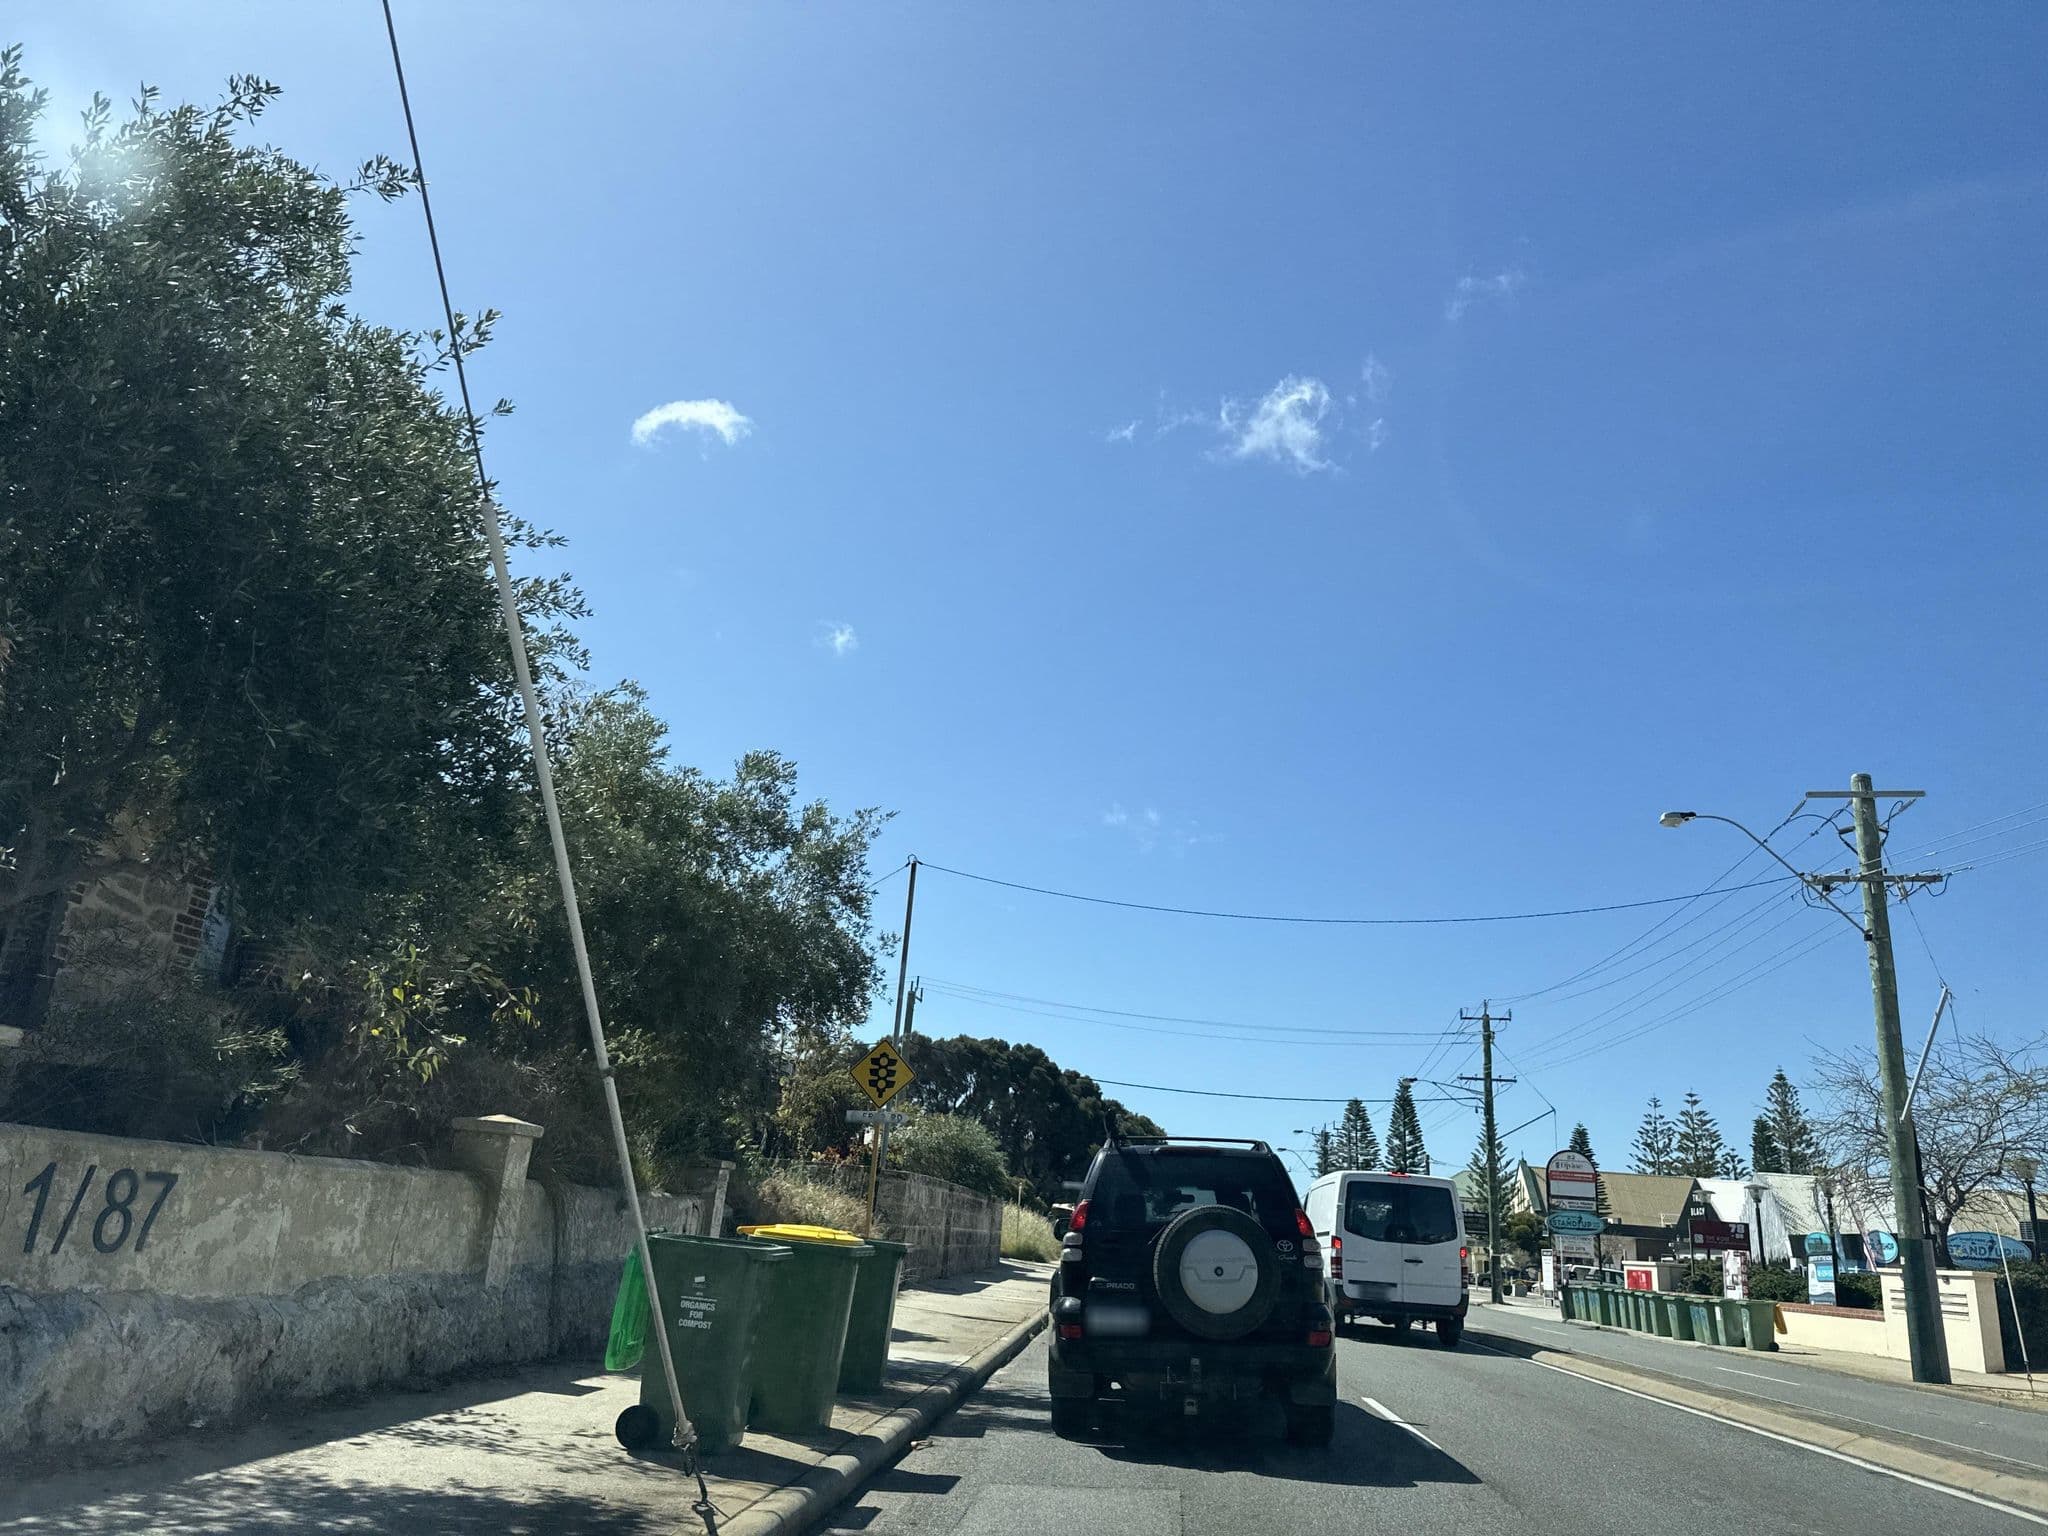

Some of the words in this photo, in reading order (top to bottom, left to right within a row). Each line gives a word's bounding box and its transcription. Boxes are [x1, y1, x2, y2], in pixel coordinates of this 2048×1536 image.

[23, 1161, 179, 1254] 1/87
[1729, 1223, 1745, 1233] 78
[1106, 1282, 1135, 1290] PRADO
[680, 1300, 716, 1311] ORGANICS
[689, 1310, 703, 1320] FOR
[678, 1319, 712, 1330] COMPOST
